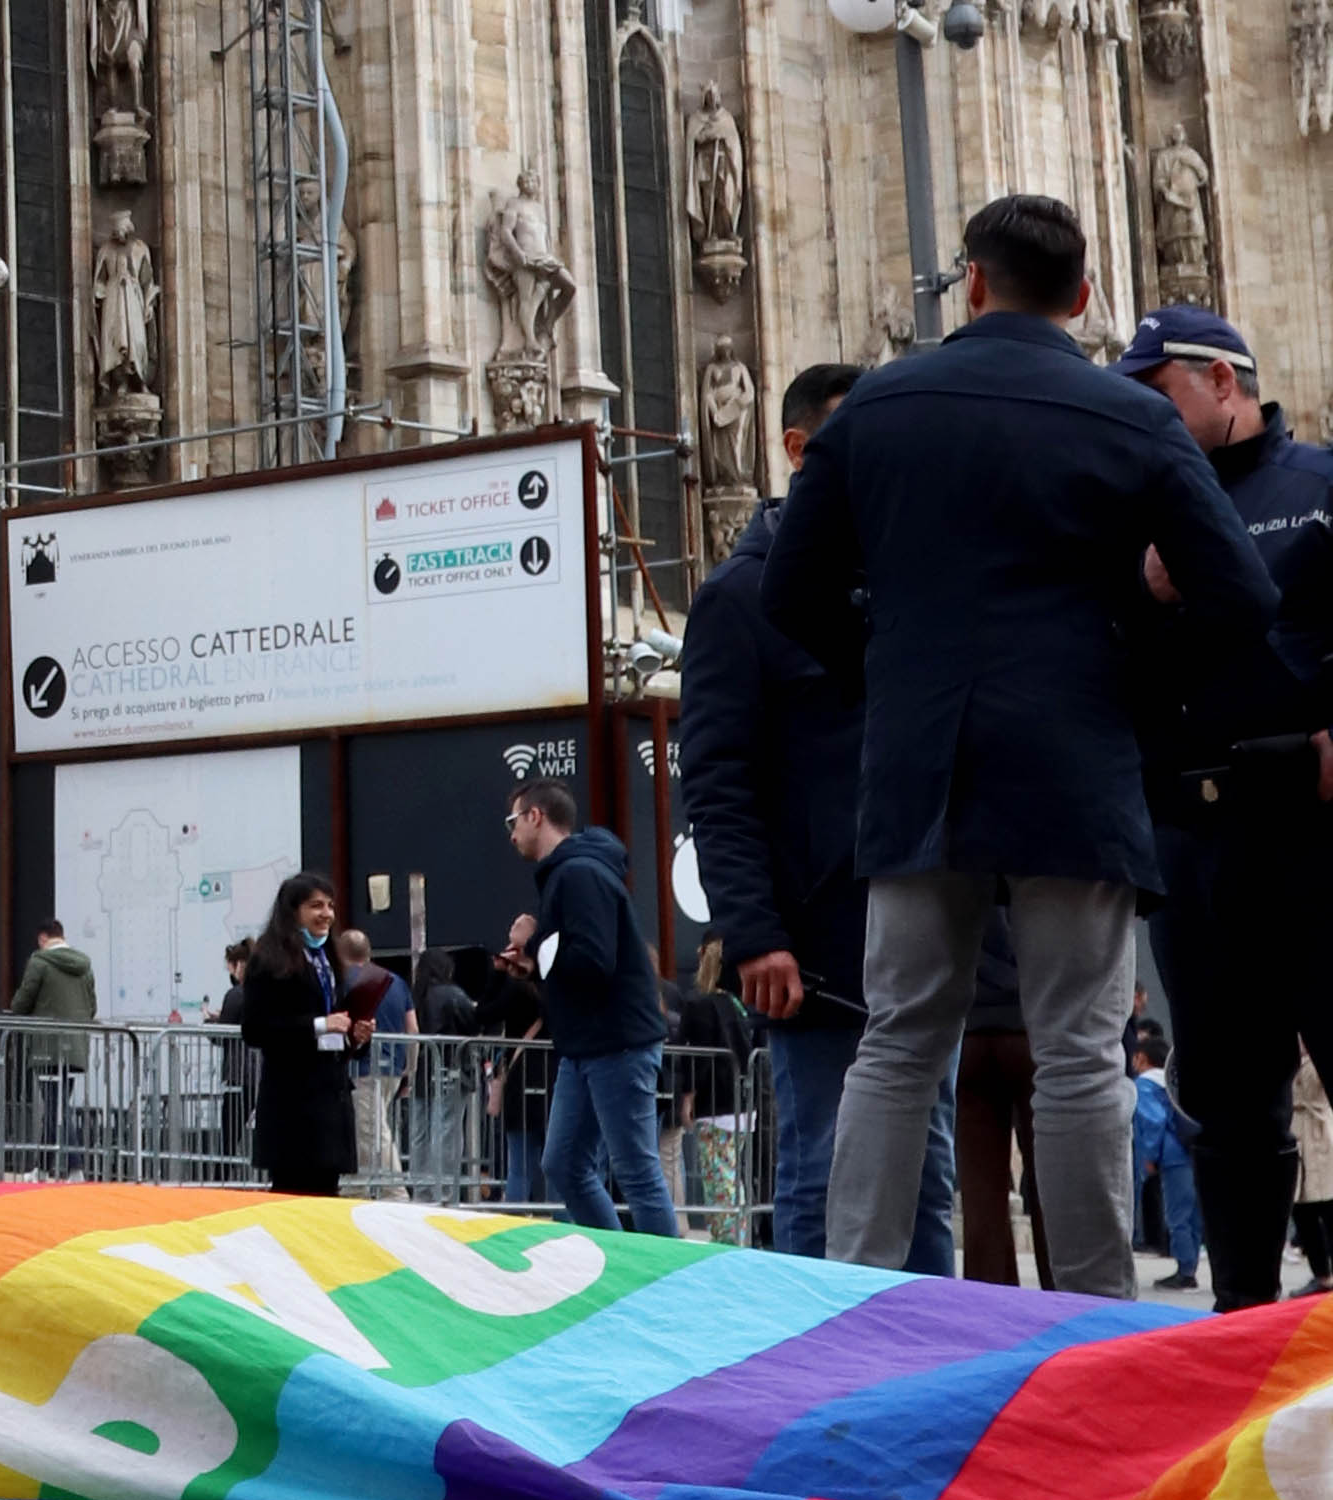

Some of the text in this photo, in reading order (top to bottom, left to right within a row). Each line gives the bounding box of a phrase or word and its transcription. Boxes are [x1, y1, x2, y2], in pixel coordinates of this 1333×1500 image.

[406, 491, 510, 518] TICKET OFFICE
[1291, 509, 1332, 528] LALE
[160, 541, 190, 553] DUOMO
[408, 543, 511, 572] FAST-TRACK
[408, 566, 513, 588] TICKET OFFICE ONLY
[72, 616, 355, 671] ACCESSO CATTEDRALE
[70, 645, 361, 699] CATHEDRAL ENTRANCE
[71, 707, 80, 720] Si
[83, 707, 109, 723] prega
[112, 704, 122, 716] di
[125, 698, 176, 716] acquistare
[180, 697, 186, 710] il
[189, 694, 231, 712] biglietto
[234, 692, 265, 710] prima
[537, 739, 576, 759] FREE
[538, 758, 575, 777] WI-FI
